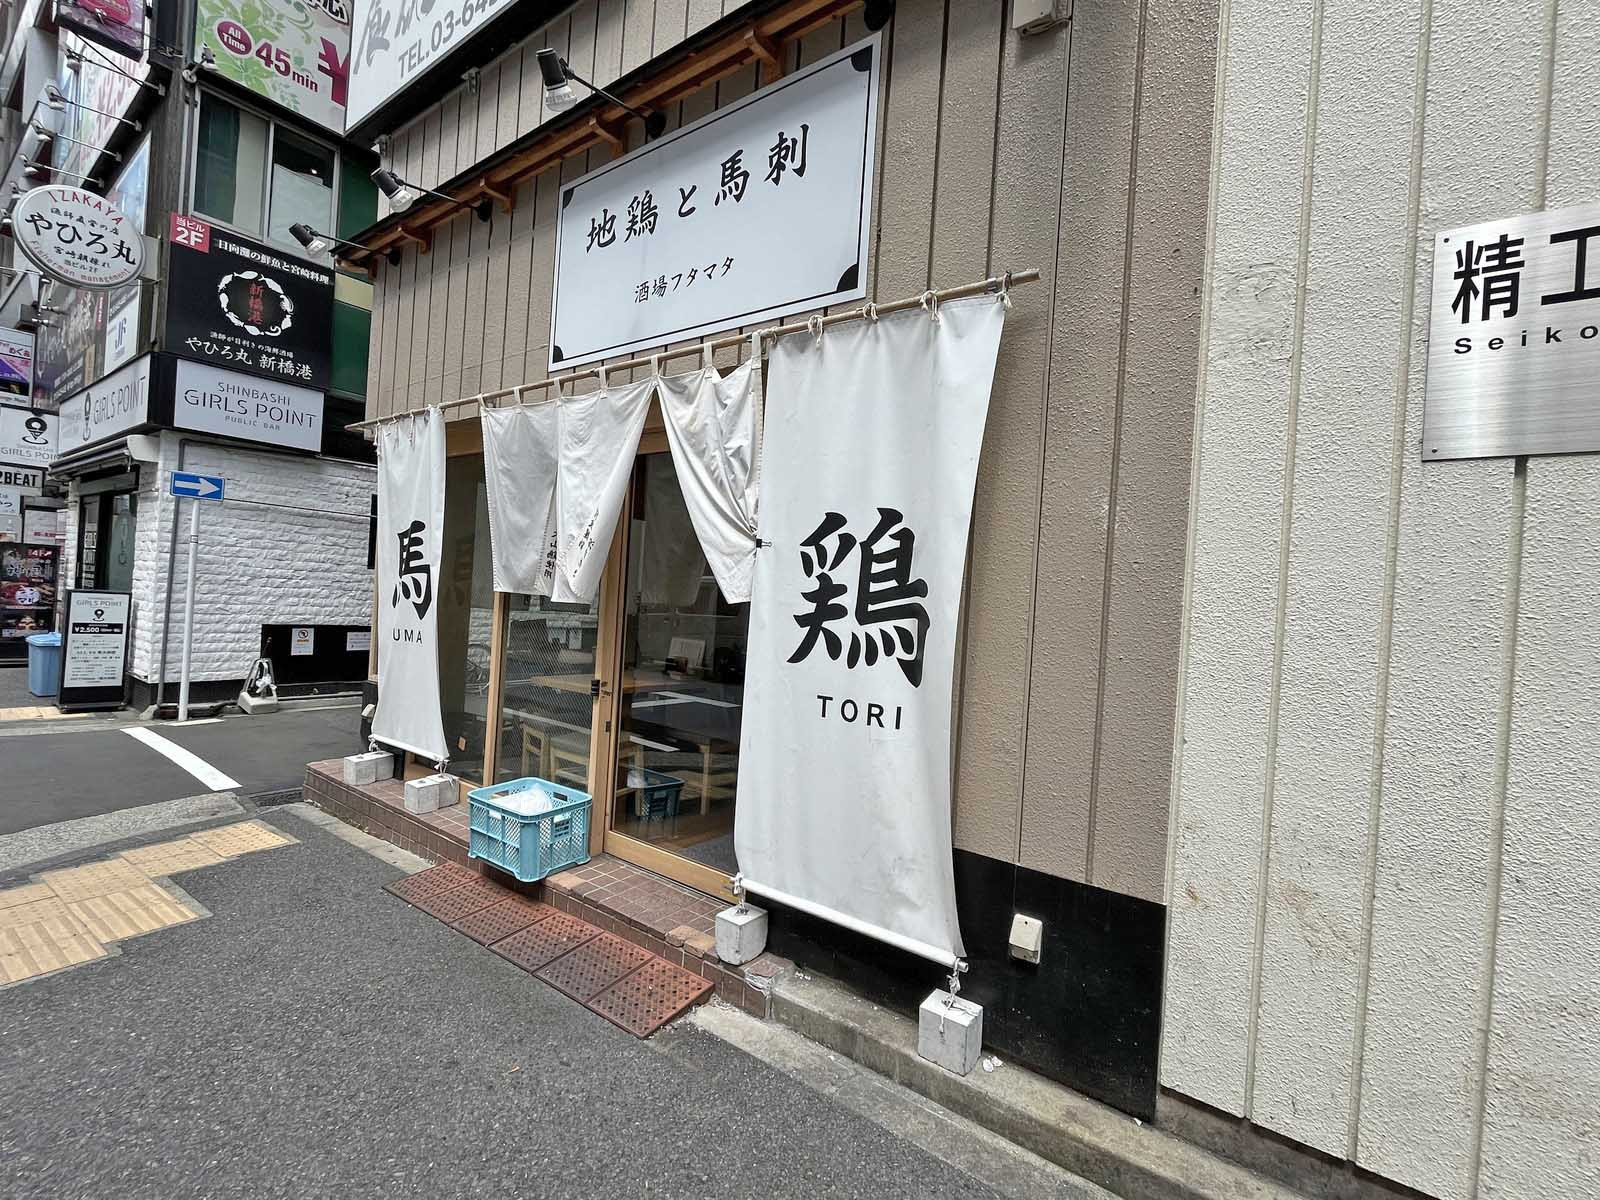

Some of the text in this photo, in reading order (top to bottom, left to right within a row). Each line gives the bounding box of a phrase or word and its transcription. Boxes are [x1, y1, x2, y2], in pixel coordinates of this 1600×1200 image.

[221, 32, 246, 52] Time
[228, 26, 241, 40] All
[586, 123, 810, 253] 地鶏と馬刺
[48, 189, 124, 226] IZAKAYA
[175, 216, 206, 232] 当ビル
[25, 211, 137, 266] やひろ丸
[175, 226, 205, 246] 2F
[634, 255, 735, 304] 酒場フタマタ
[1451, 226, 1600, 324] 精工
[185, 336, 313, 380] やひろ丸 新橋港
[1453, 325, 1599, 355] Seiko
[117, 375, 146, 415] POINT
[184, 389, 317, 428] GIRLS POINT
[217, 381, 291, 406] SHINBASHI
[225, 415, 281, 432] PUBLIC BAR
[0, 447, 32, 457] GIRLS
[392, 520, 432, 621] 馬
[786, 507, 931, 689] 鶏
[392, 628, 423, 644] UMA
[816, 694, 902, 730] TORI
